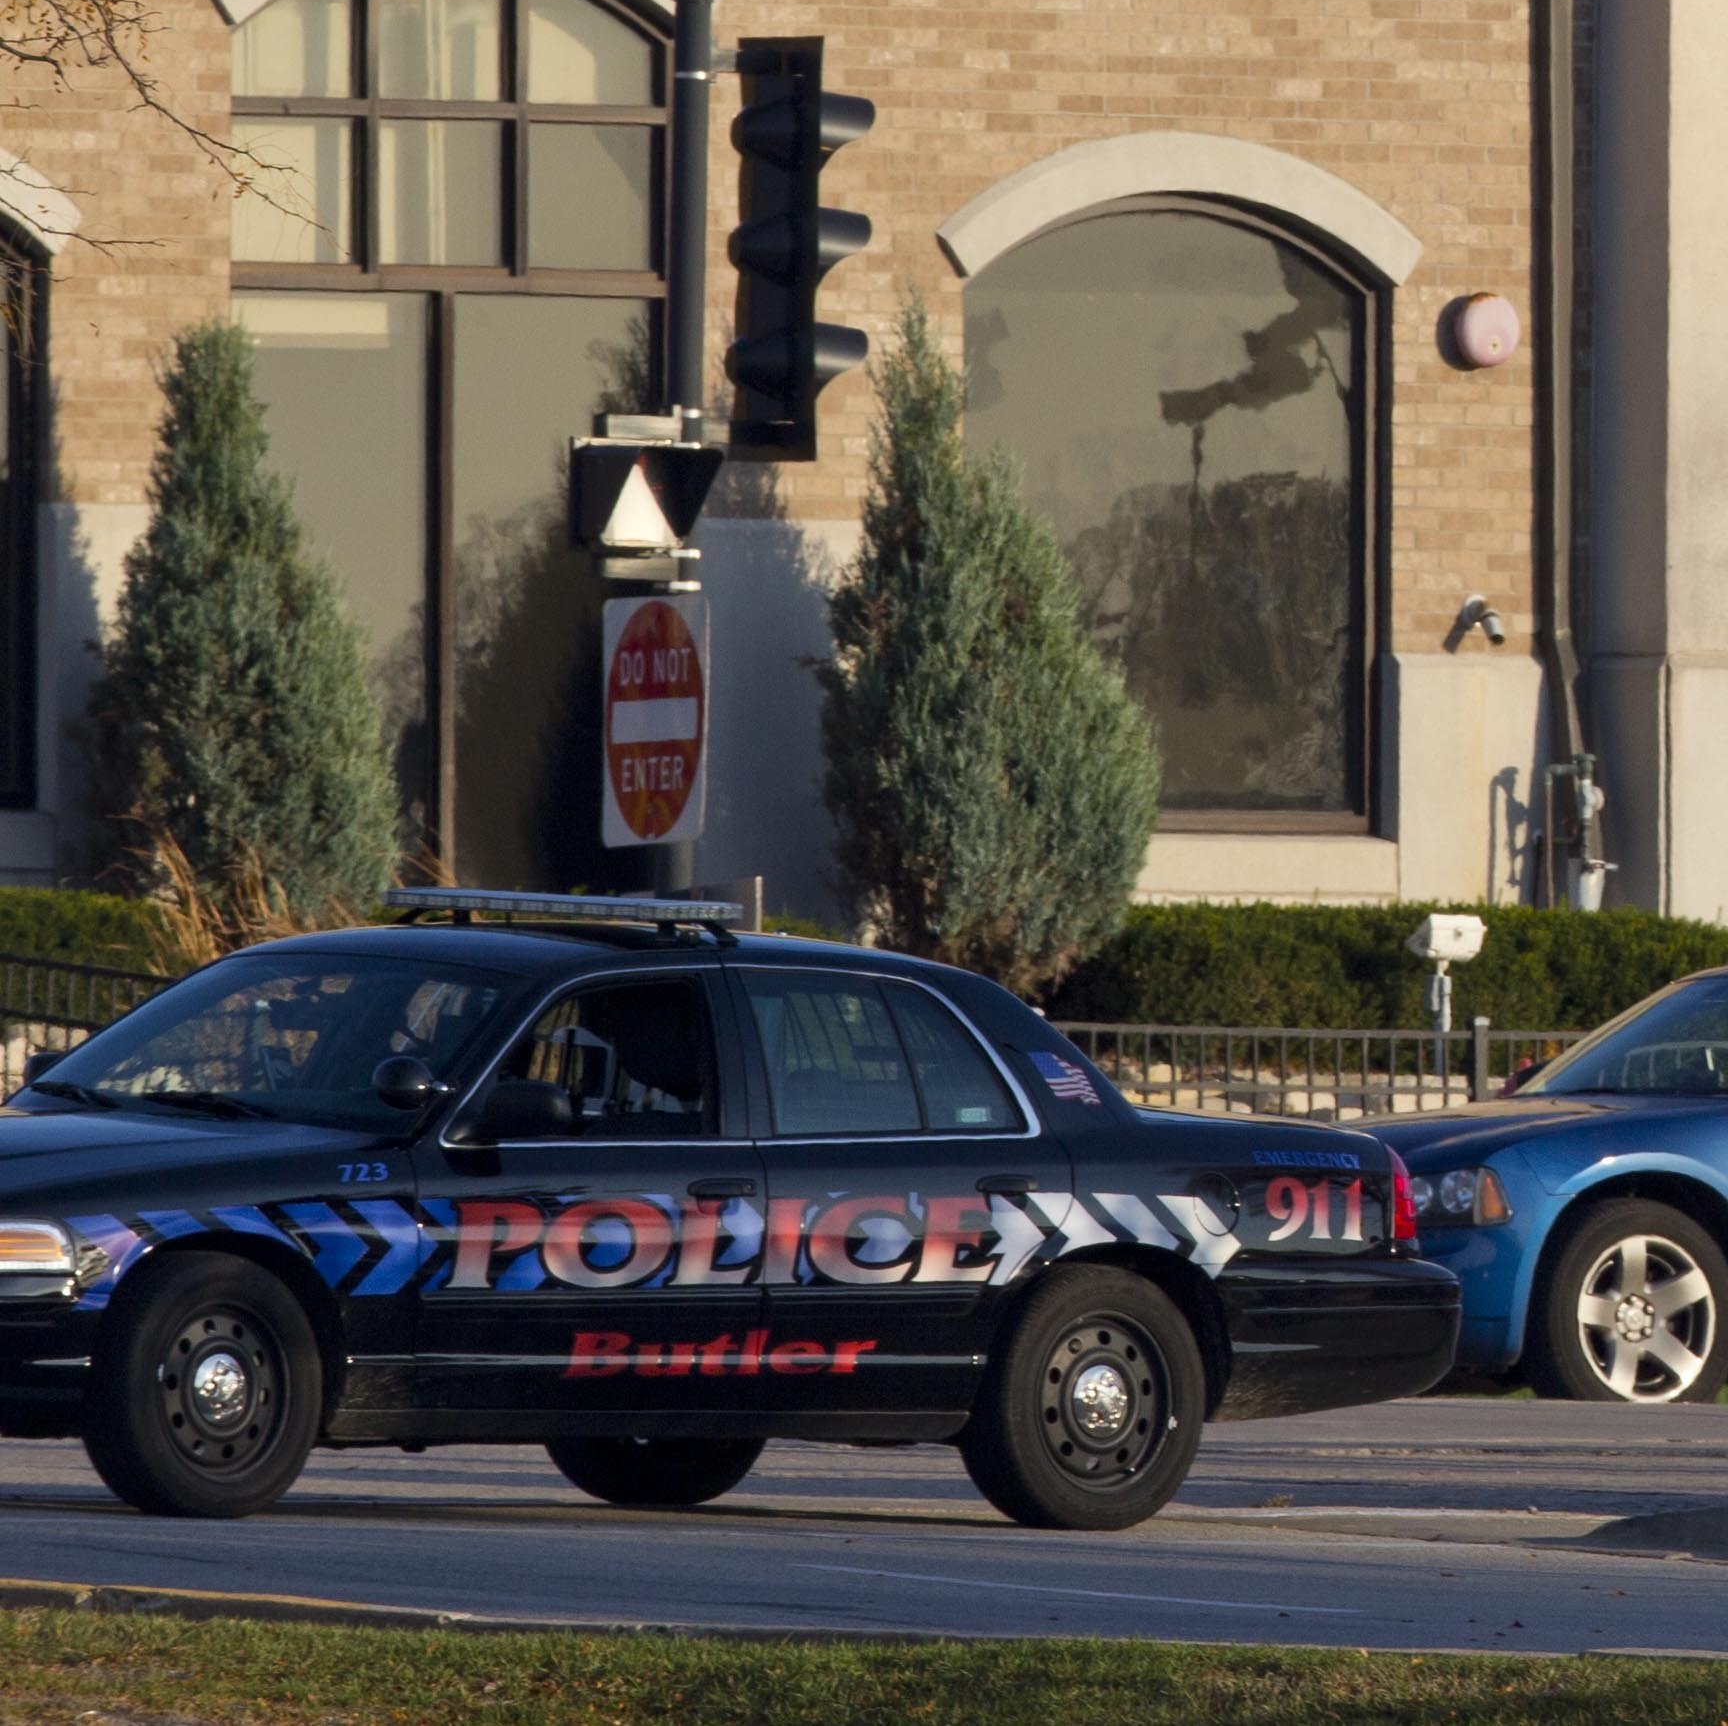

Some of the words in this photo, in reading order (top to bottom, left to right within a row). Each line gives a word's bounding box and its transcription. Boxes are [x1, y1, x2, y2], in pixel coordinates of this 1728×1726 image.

[620, 651, 645, 687] DO
[652, 647, 692, 684] NOT
[620, 756, 685, 793] ENTER
[336, 1162, 389, 1183] 723
[1252, 1151, 1361, 1170] EMERGENCY
[1264, 1175, 1364, 1242] 911
[442, 1194, 999, 1287] POLICE
[560, 1328, 876, 1379] Butler
